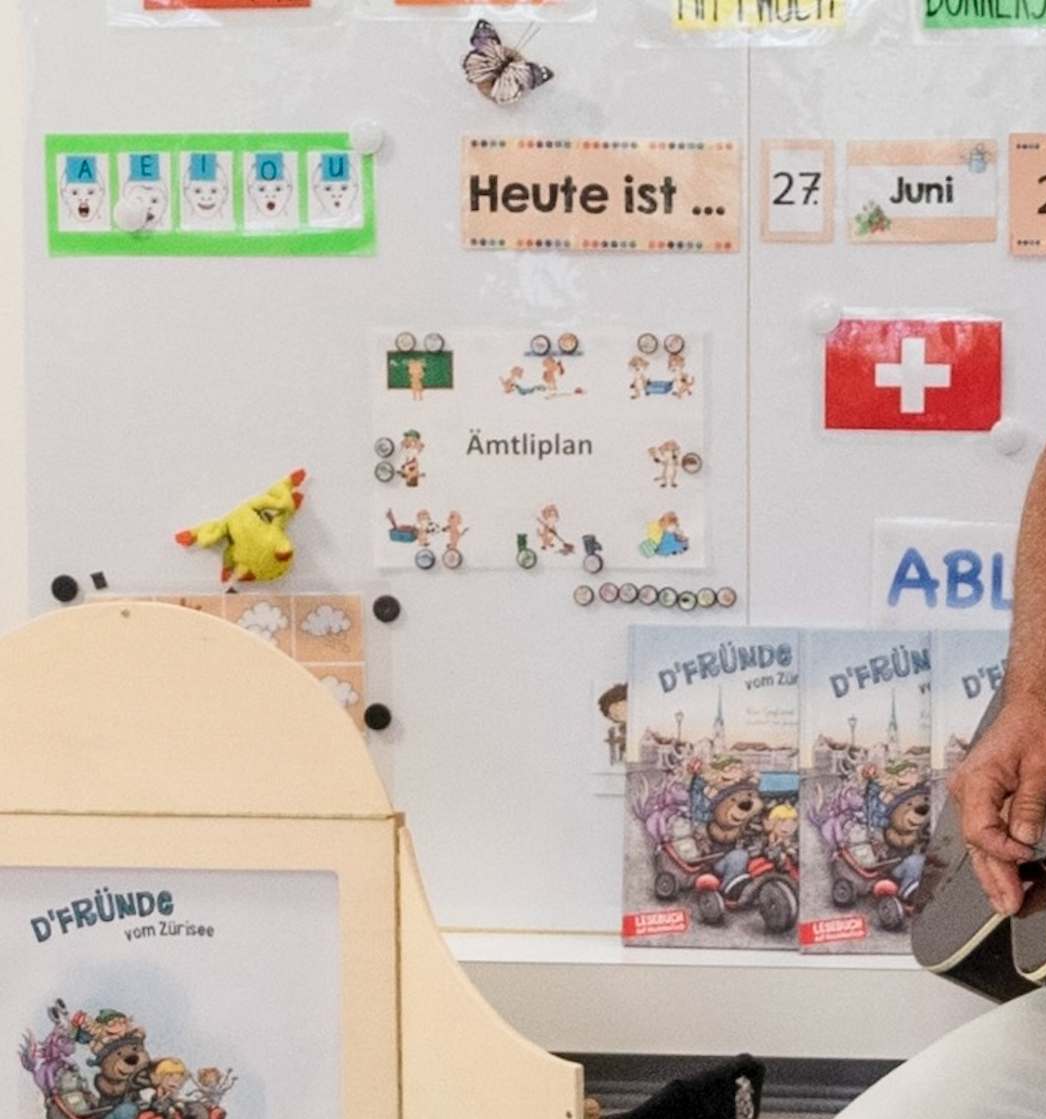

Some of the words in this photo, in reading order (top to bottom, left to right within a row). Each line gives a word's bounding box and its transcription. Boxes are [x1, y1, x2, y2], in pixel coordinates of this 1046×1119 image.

[78, 159, 92, 179] A
[141, 155, 151, 177] E
[260, 160, 277, 181] O
[329, 156, 344, 178] U
[470, 175, 609, 215] Heute
[624, 173, 677, 215] ist
[773, 172, 821, 206] 27.
[890, 176, 954, 205] Juni
[467, 429, 593, 461] Ämtliplan
[124, 925, 156, 942] vom
[159, 920, 216, 939] Zürisee
